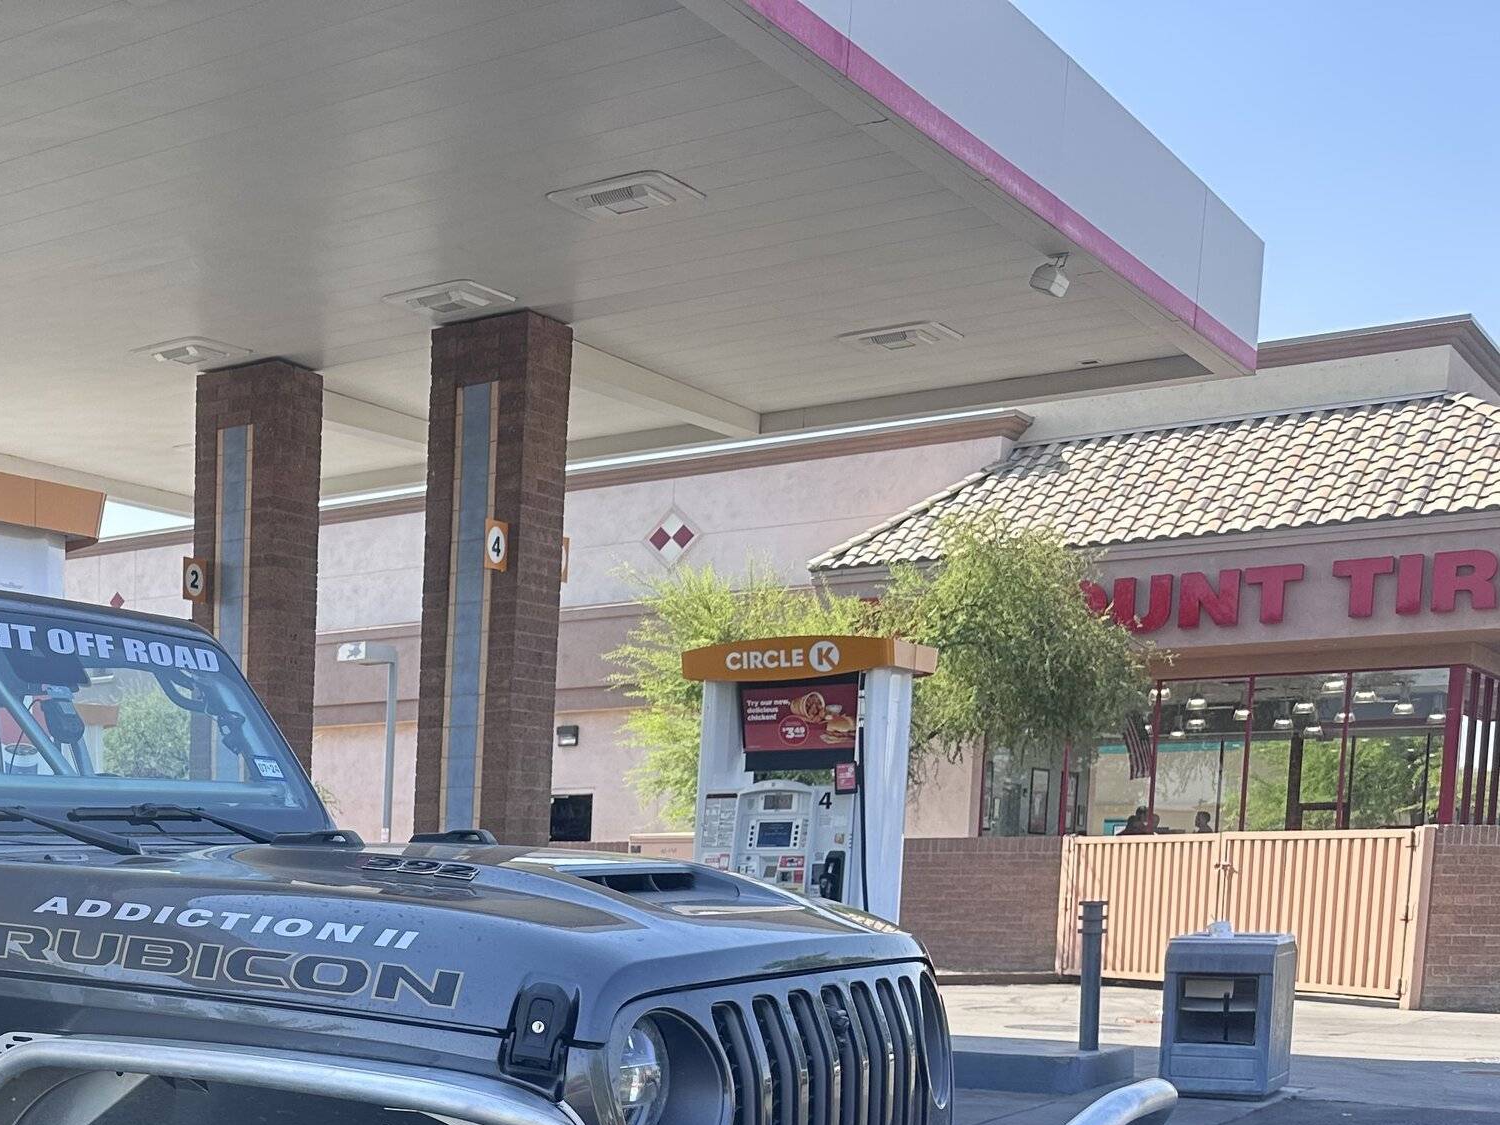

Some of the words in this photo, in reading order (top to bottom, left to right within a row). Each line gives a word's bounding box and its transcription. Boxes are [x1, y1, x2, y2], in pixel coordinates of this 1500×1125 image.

[492, 536, 501, 557] 4
[190, 570, 199, 589] 2
[49, 628, 114, 659] OFF
[124, 638, 220, 673] ROAD
[725, 648, 805, 671] CIRCLE
[811, 643, 839, 671] K
[819, 792, 833, 810] 4
[361, 856, 480, 881] 392
[33, 896, 365, 943] ADDICTION
[374, 929, 420, 950] II
